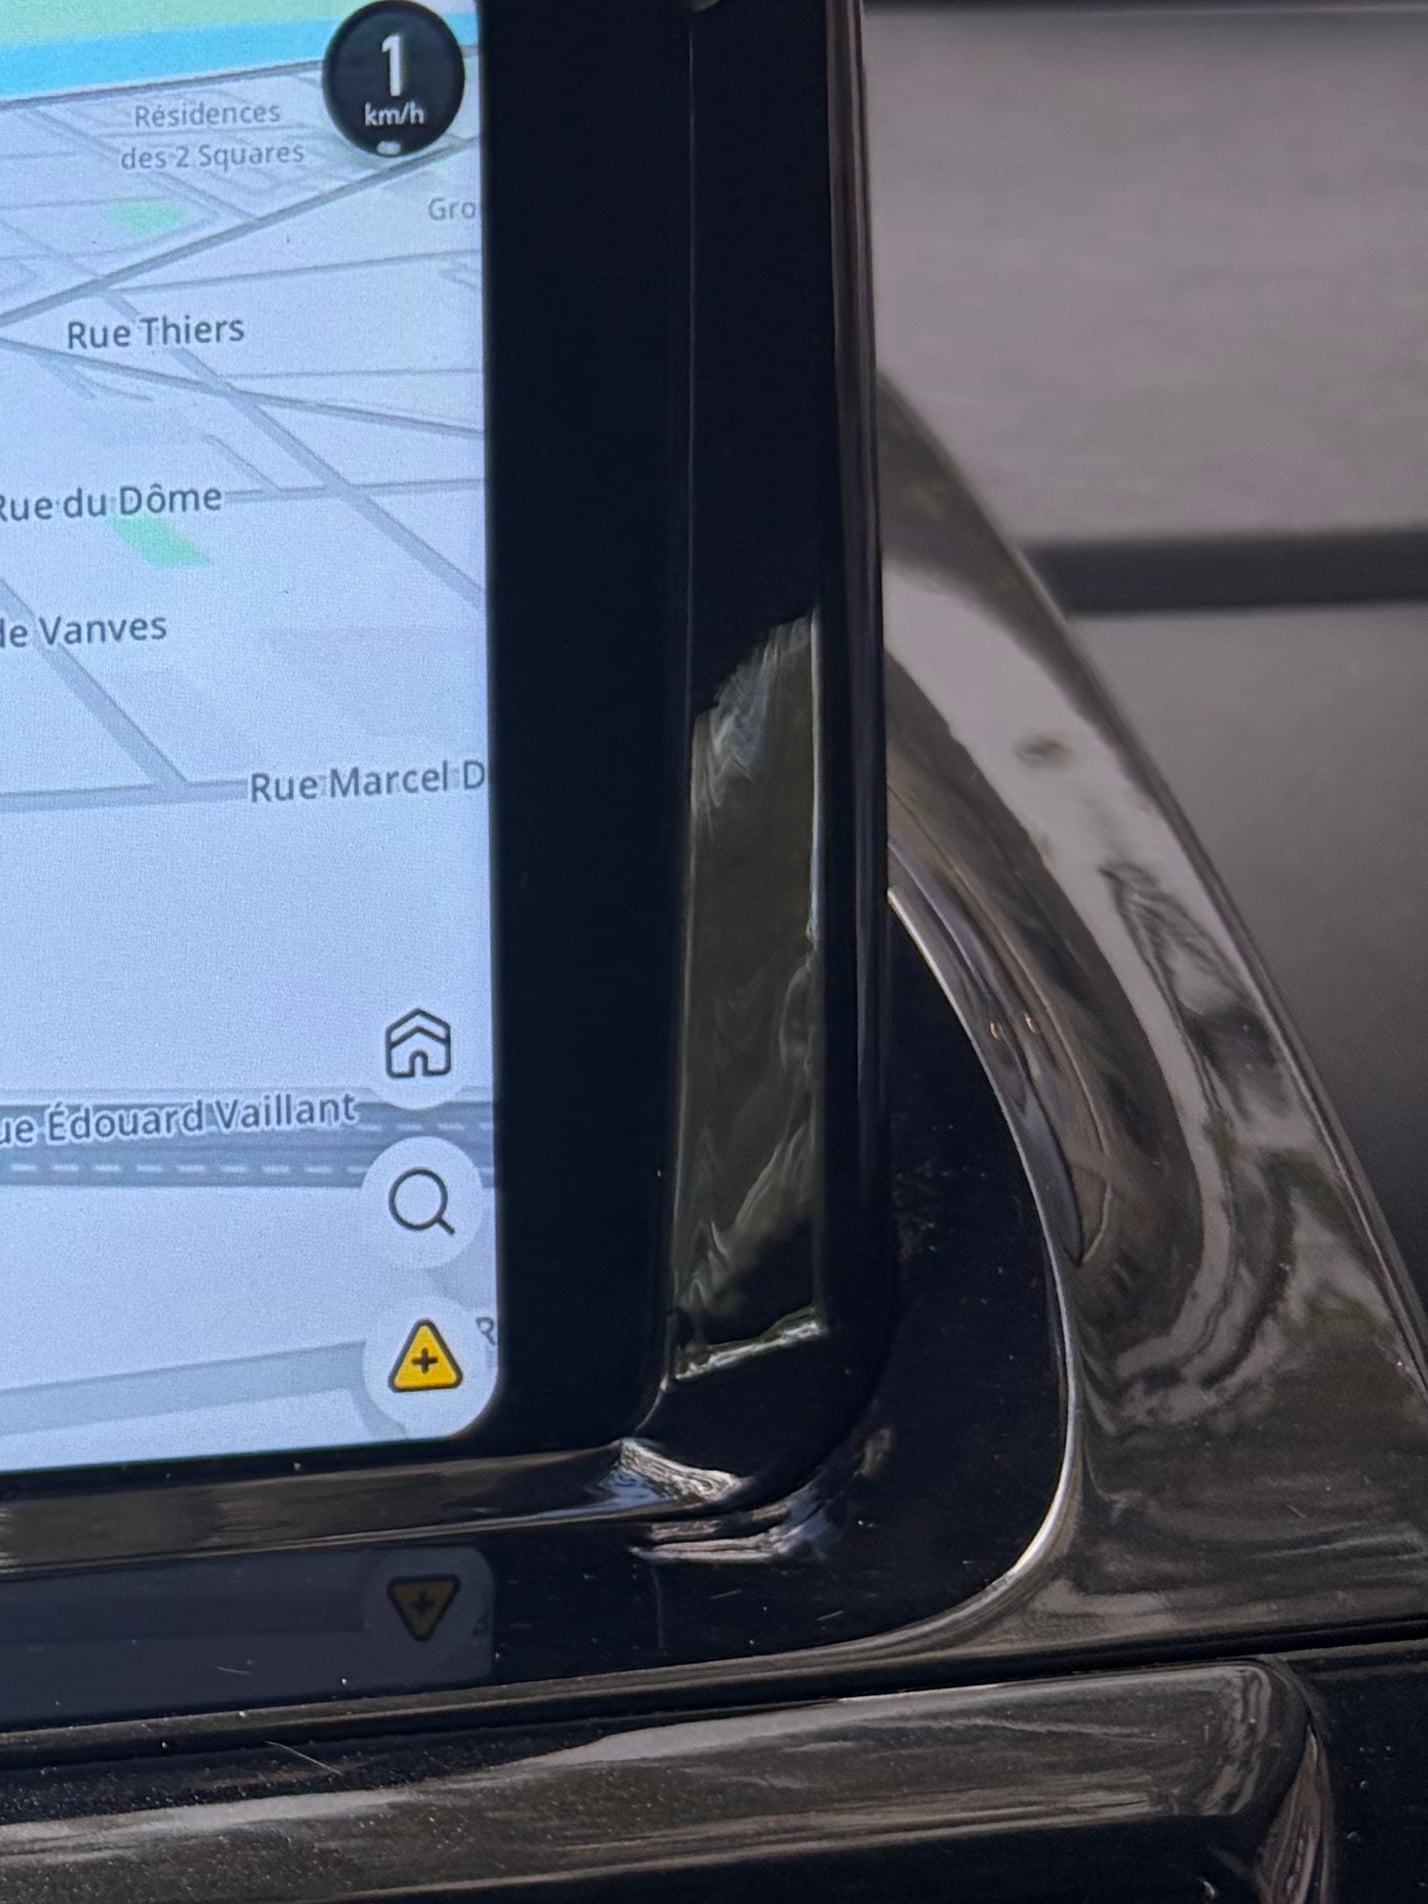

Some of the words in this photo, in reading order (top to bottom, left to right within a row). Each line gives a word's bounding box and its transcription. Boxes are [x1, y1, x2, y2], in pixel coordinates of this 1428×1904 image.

[381, 33, 402, 97] 1
[134, 98, 282, 130] Résidences
[364, 101, 425, 127] km/h
[120, 145, 165, 172] des
[175, 145, 192, 171] 2
[198, 141, 306, 175] Squares
[67, 318, 134, 350] Rue
[140, 314, 246, 346] Thiers
[64, 485, 108, 518] du
[119, 483, 224, 516] Dôme
[39, 615, 169, 647] Vanves
[250, 771, 319, 804] Rue
[329, 761, 449, 797] Marcel
[463, 760, 486, 792] D
[46, 1102, 205, 1144] Édouard
[214, 1092, 358, 1131] Vaillant
